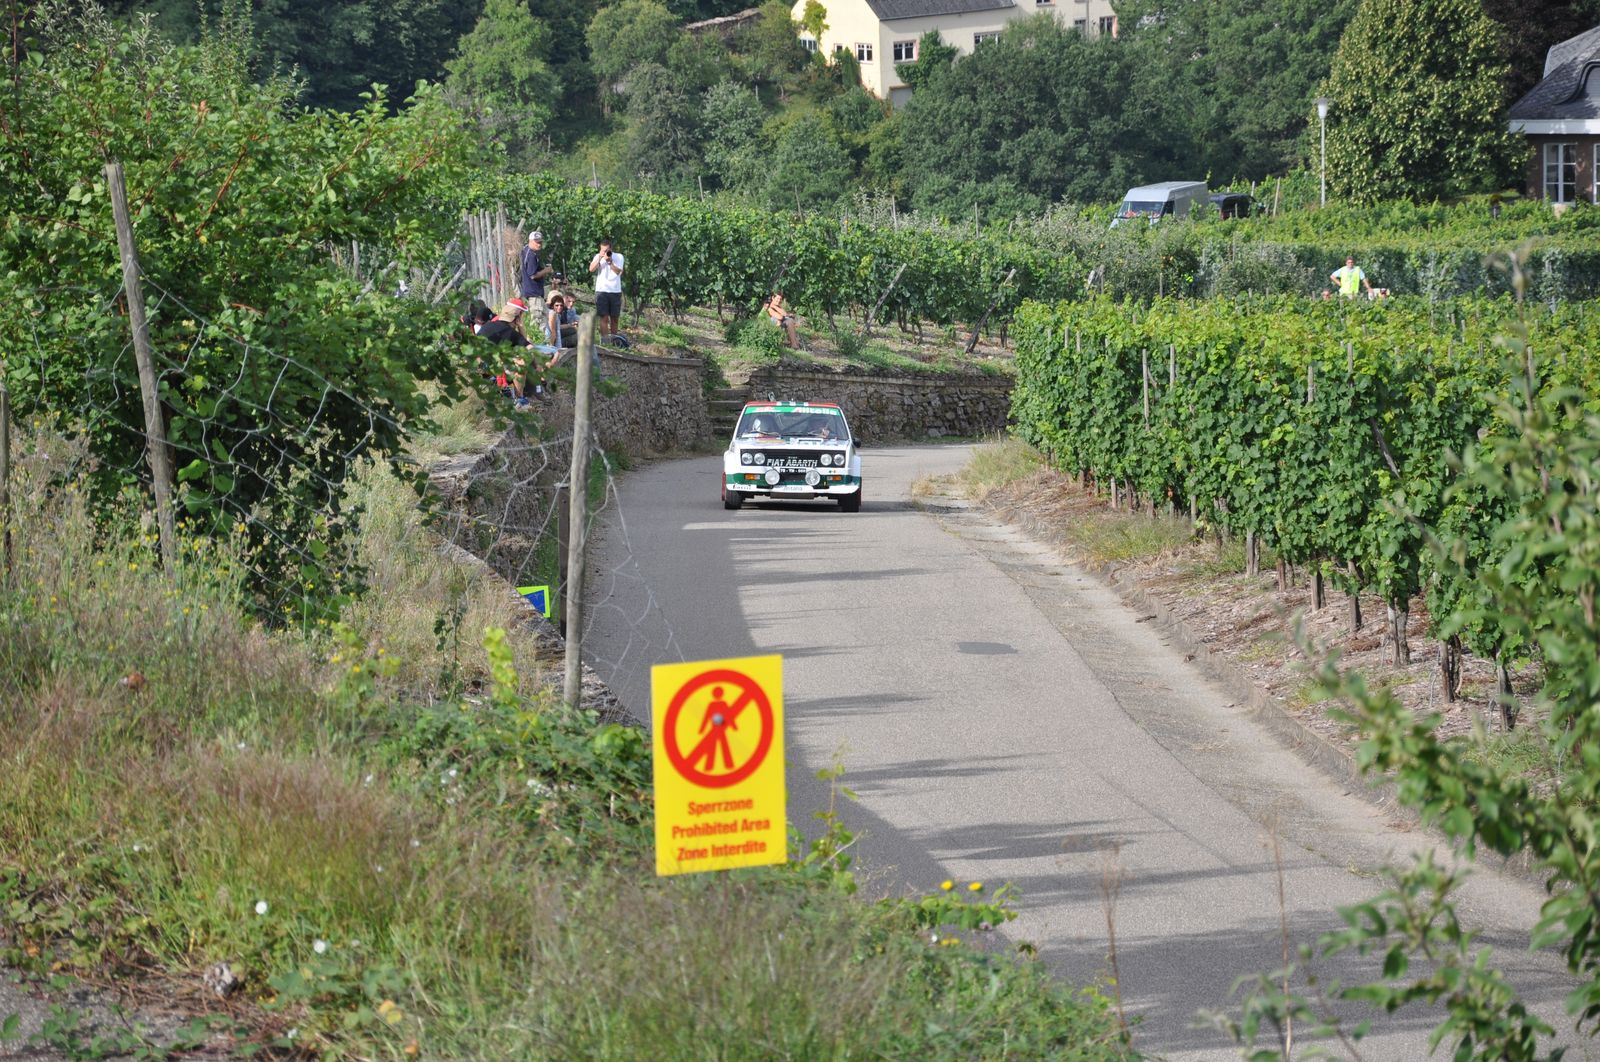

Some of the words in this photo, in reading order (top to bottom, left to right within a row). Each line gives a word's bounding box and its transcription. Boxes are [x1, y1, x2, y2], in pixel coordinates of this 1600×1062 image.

[767, 458, 785, 467] FIAT
[785, 459, 817, 468] ABARTH
[687, 799, 754, 817] Sperrzone
[672, 820, 738, 839] Prohibited
[741, 819, 771, 832] Area
[677, 847, 708, 862] Zone
[711, 841, 767, 857] Interdite
